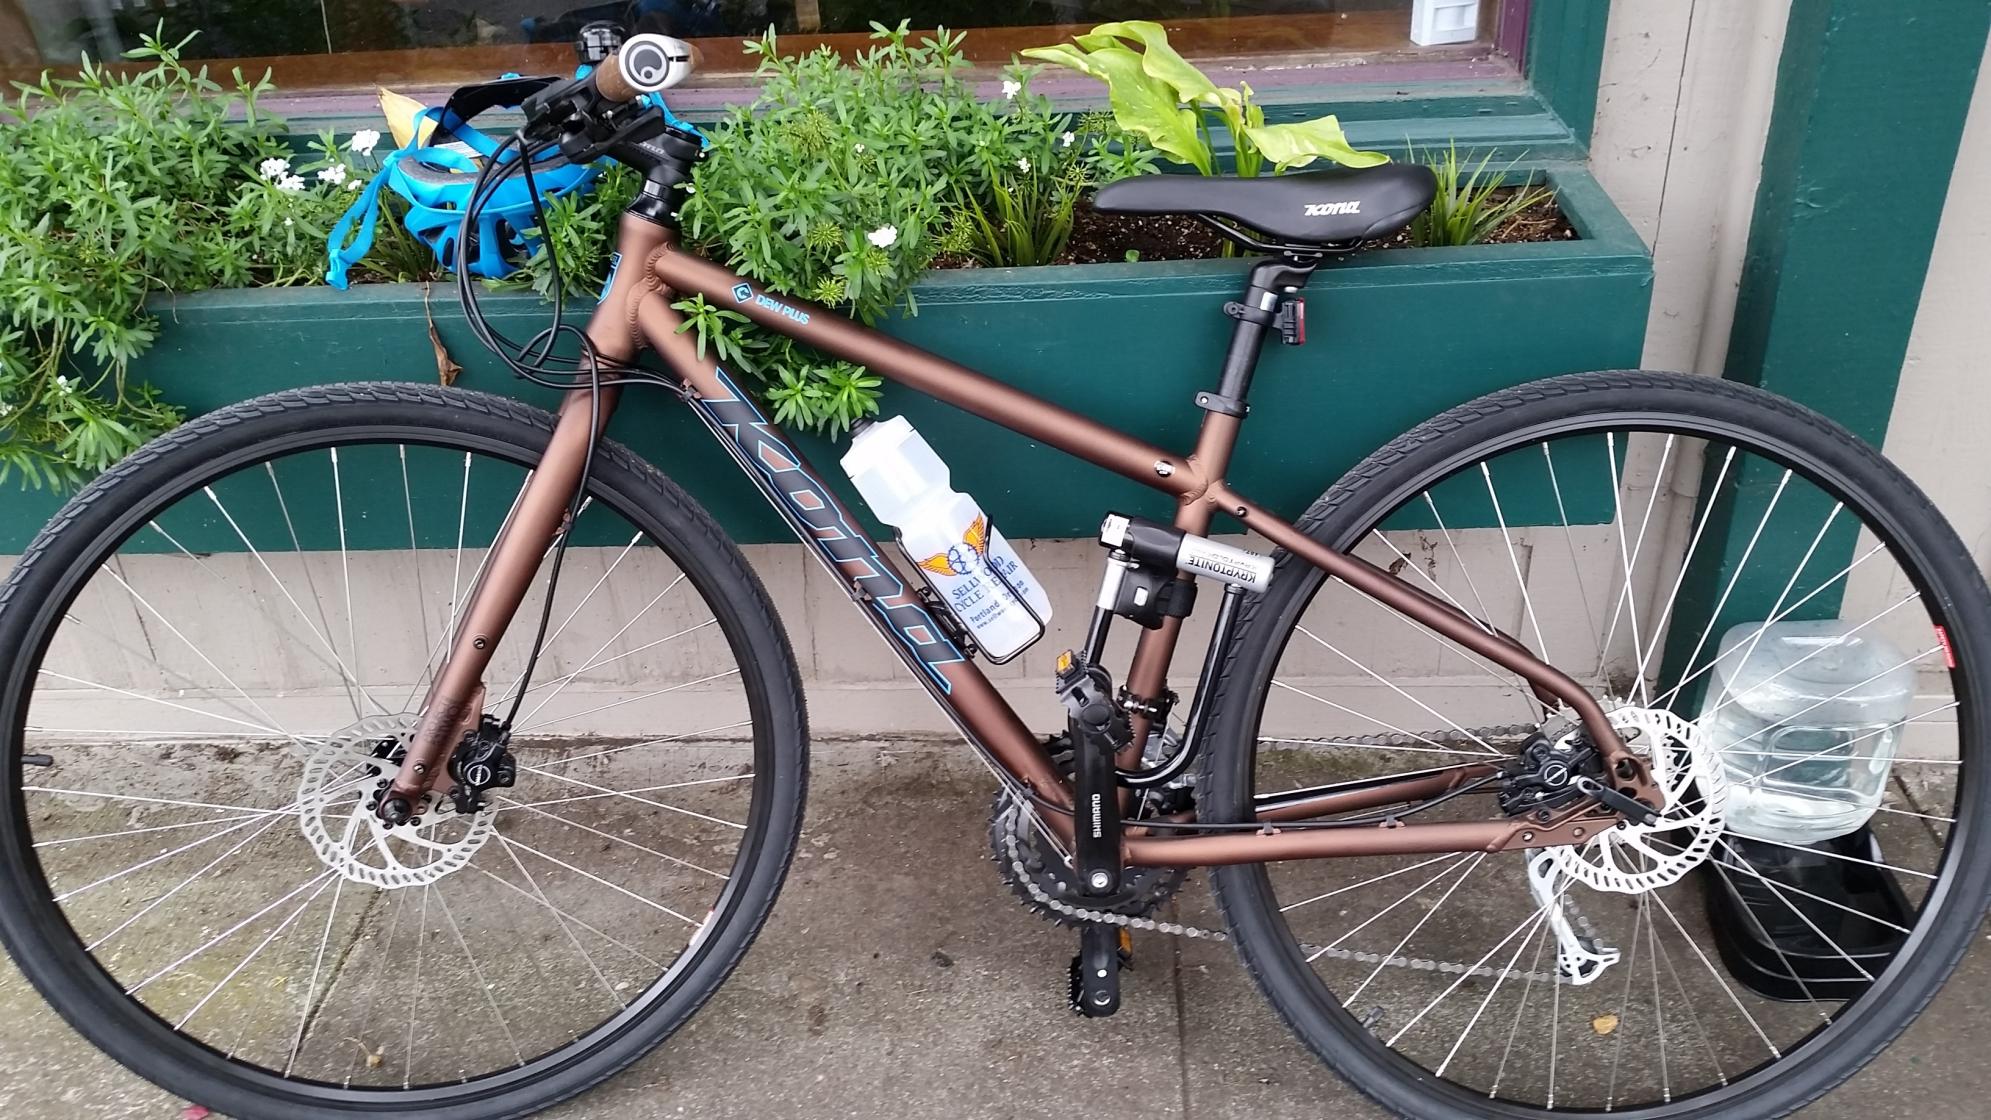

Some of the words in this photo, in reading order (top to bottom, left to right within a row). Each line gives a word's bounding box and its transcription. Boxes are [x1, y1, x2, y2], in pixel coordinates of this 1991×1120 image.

[755, 294, 783, 313] DEW
[782, 305, 811, 325] PLUS
[952, 556, 1004, 600] SELLOD
[1187, 555, 1257, 584] KRYPTONITE
[954, 589, 985, 613] CYCLE
[1091, 793, 1102, 838] SHIMANO
